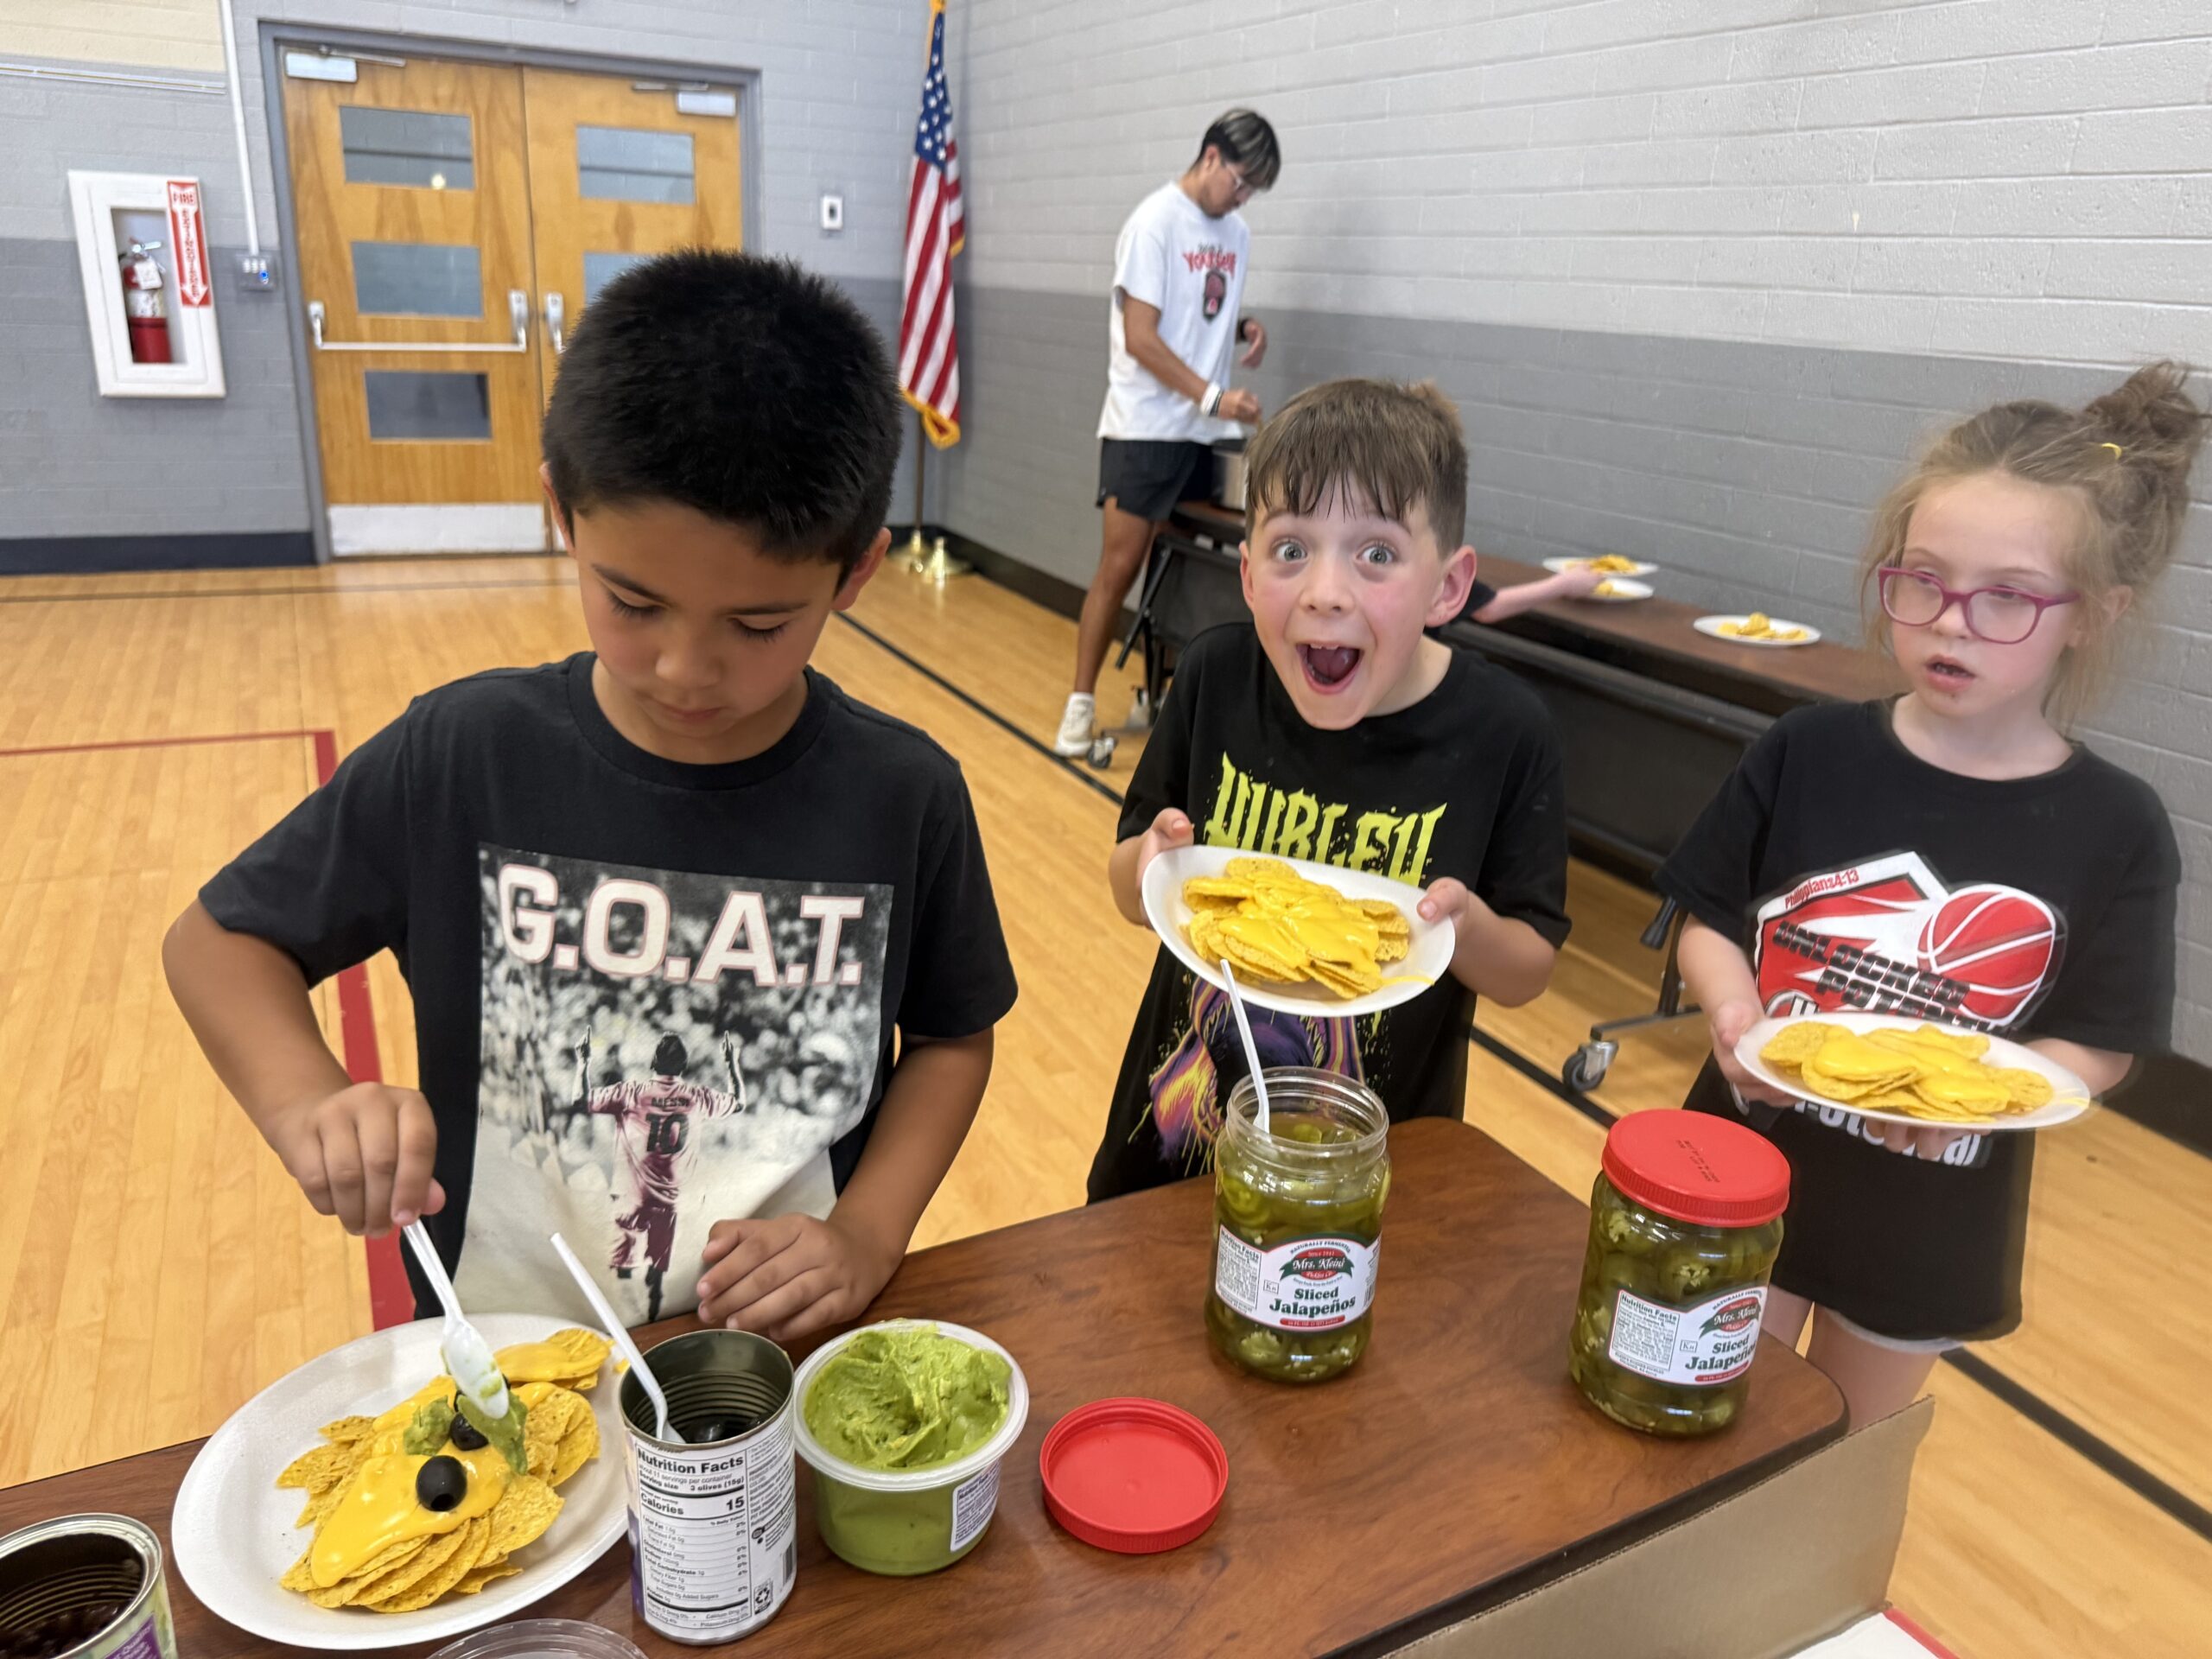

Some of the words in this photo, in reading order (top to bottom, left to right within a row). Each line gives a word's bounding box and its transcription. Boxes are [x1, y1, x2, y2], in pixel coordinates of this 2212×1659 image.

[645, 1112, 690, 1154] 10
[1293, 1258, 1315, 1270] Mrs.
[1294, 1286, 1338, 1300] Sliced
[1268, 1295, 1356, 1319] Jalapeños
[1713, 1312, 1735, 1326] Mrs.
[1712, 1333, 1750, 1354] Sliced
[637, 1447, 696, 1474] Nutrition
[701, 1456, 745, 1474] Facts
[640, 1491, 684, 1516] Calories
[726, 1496, 745, 1511] 15
